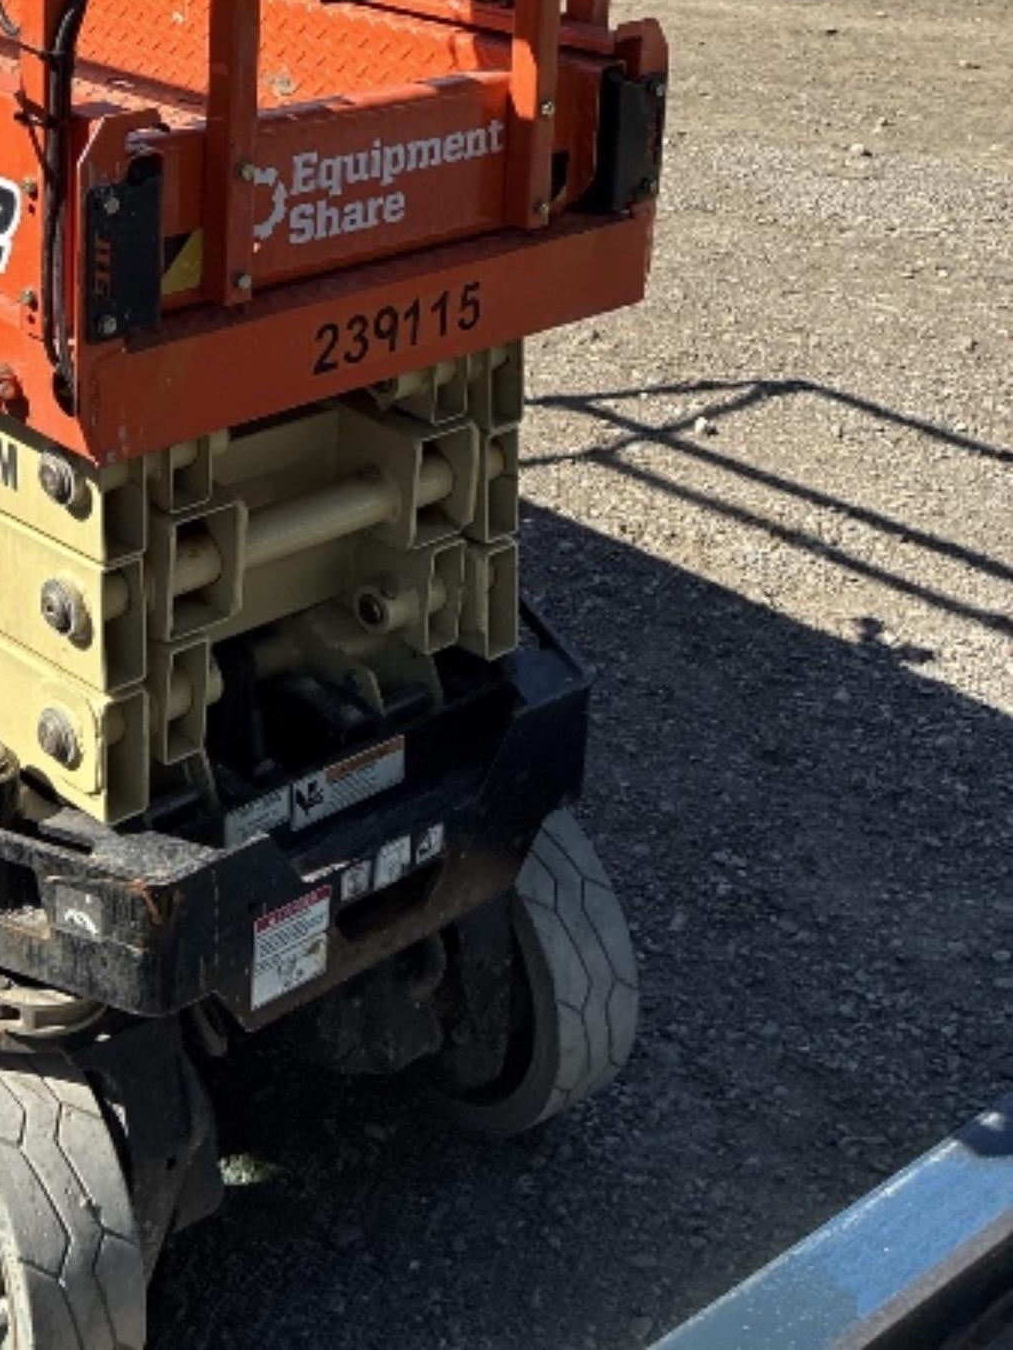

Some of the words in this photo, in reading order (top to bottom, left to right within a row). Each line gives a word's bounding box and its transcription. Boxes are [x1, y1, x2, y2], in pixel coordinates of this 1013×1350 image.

[290, 119, 504, 196] Equipment
[290, 190, 406, 246] Share
[312, 281, 482, 375] 239115
